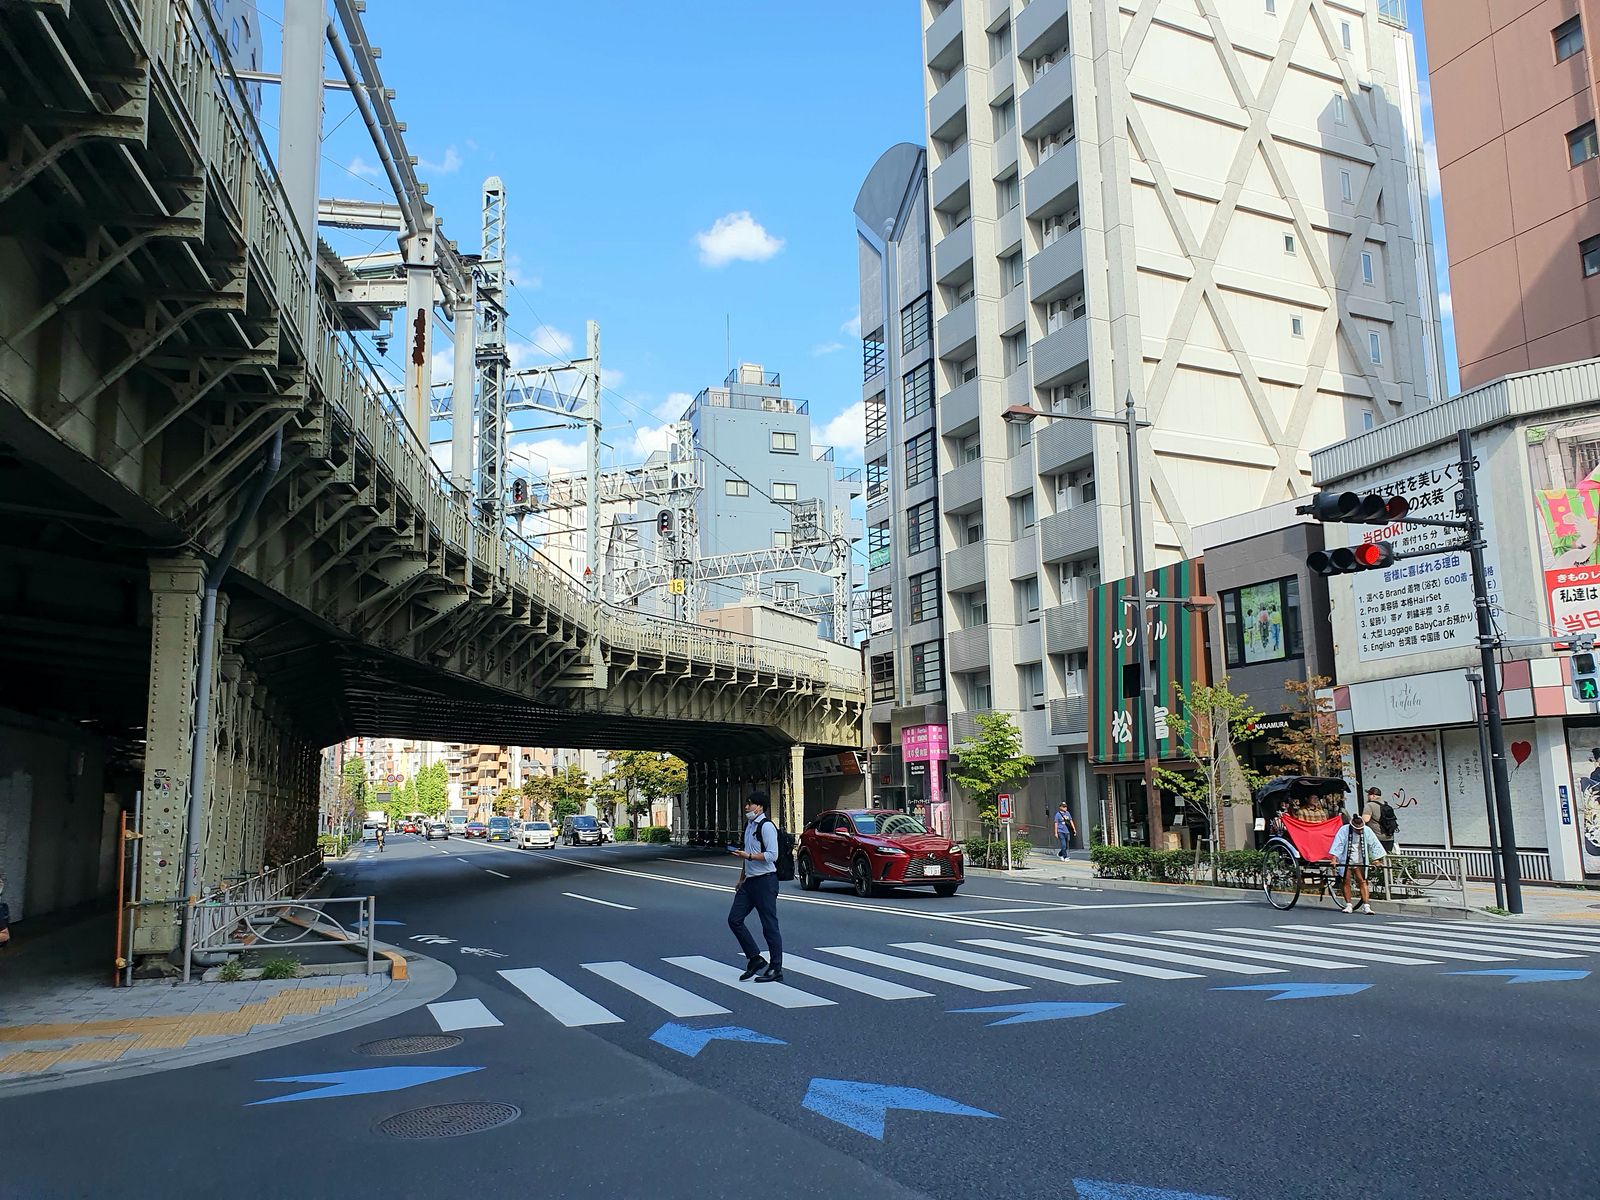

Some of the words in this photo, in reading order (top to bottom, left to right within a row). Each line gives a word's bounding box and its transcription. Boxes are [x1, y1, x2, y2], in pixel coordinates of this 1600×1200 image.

[1383, 555, 1461, 583] 皆様に喜ばれる理由
[672, 581, 683, 592] 15
[1386, 586, 1406, 598] Brand
[1559, 586, 1599, 604] 私達は
[1367, 605, 1379, 615] Pro
[1112, 620, 1168, 649] サンル
[1371, 640, 1395, 651] English
[1420, 631, 1440, 643] 中国語
[1443, 630, 1456, 640] OK
[1254, 721, 1289, 729] NAKAMURA
